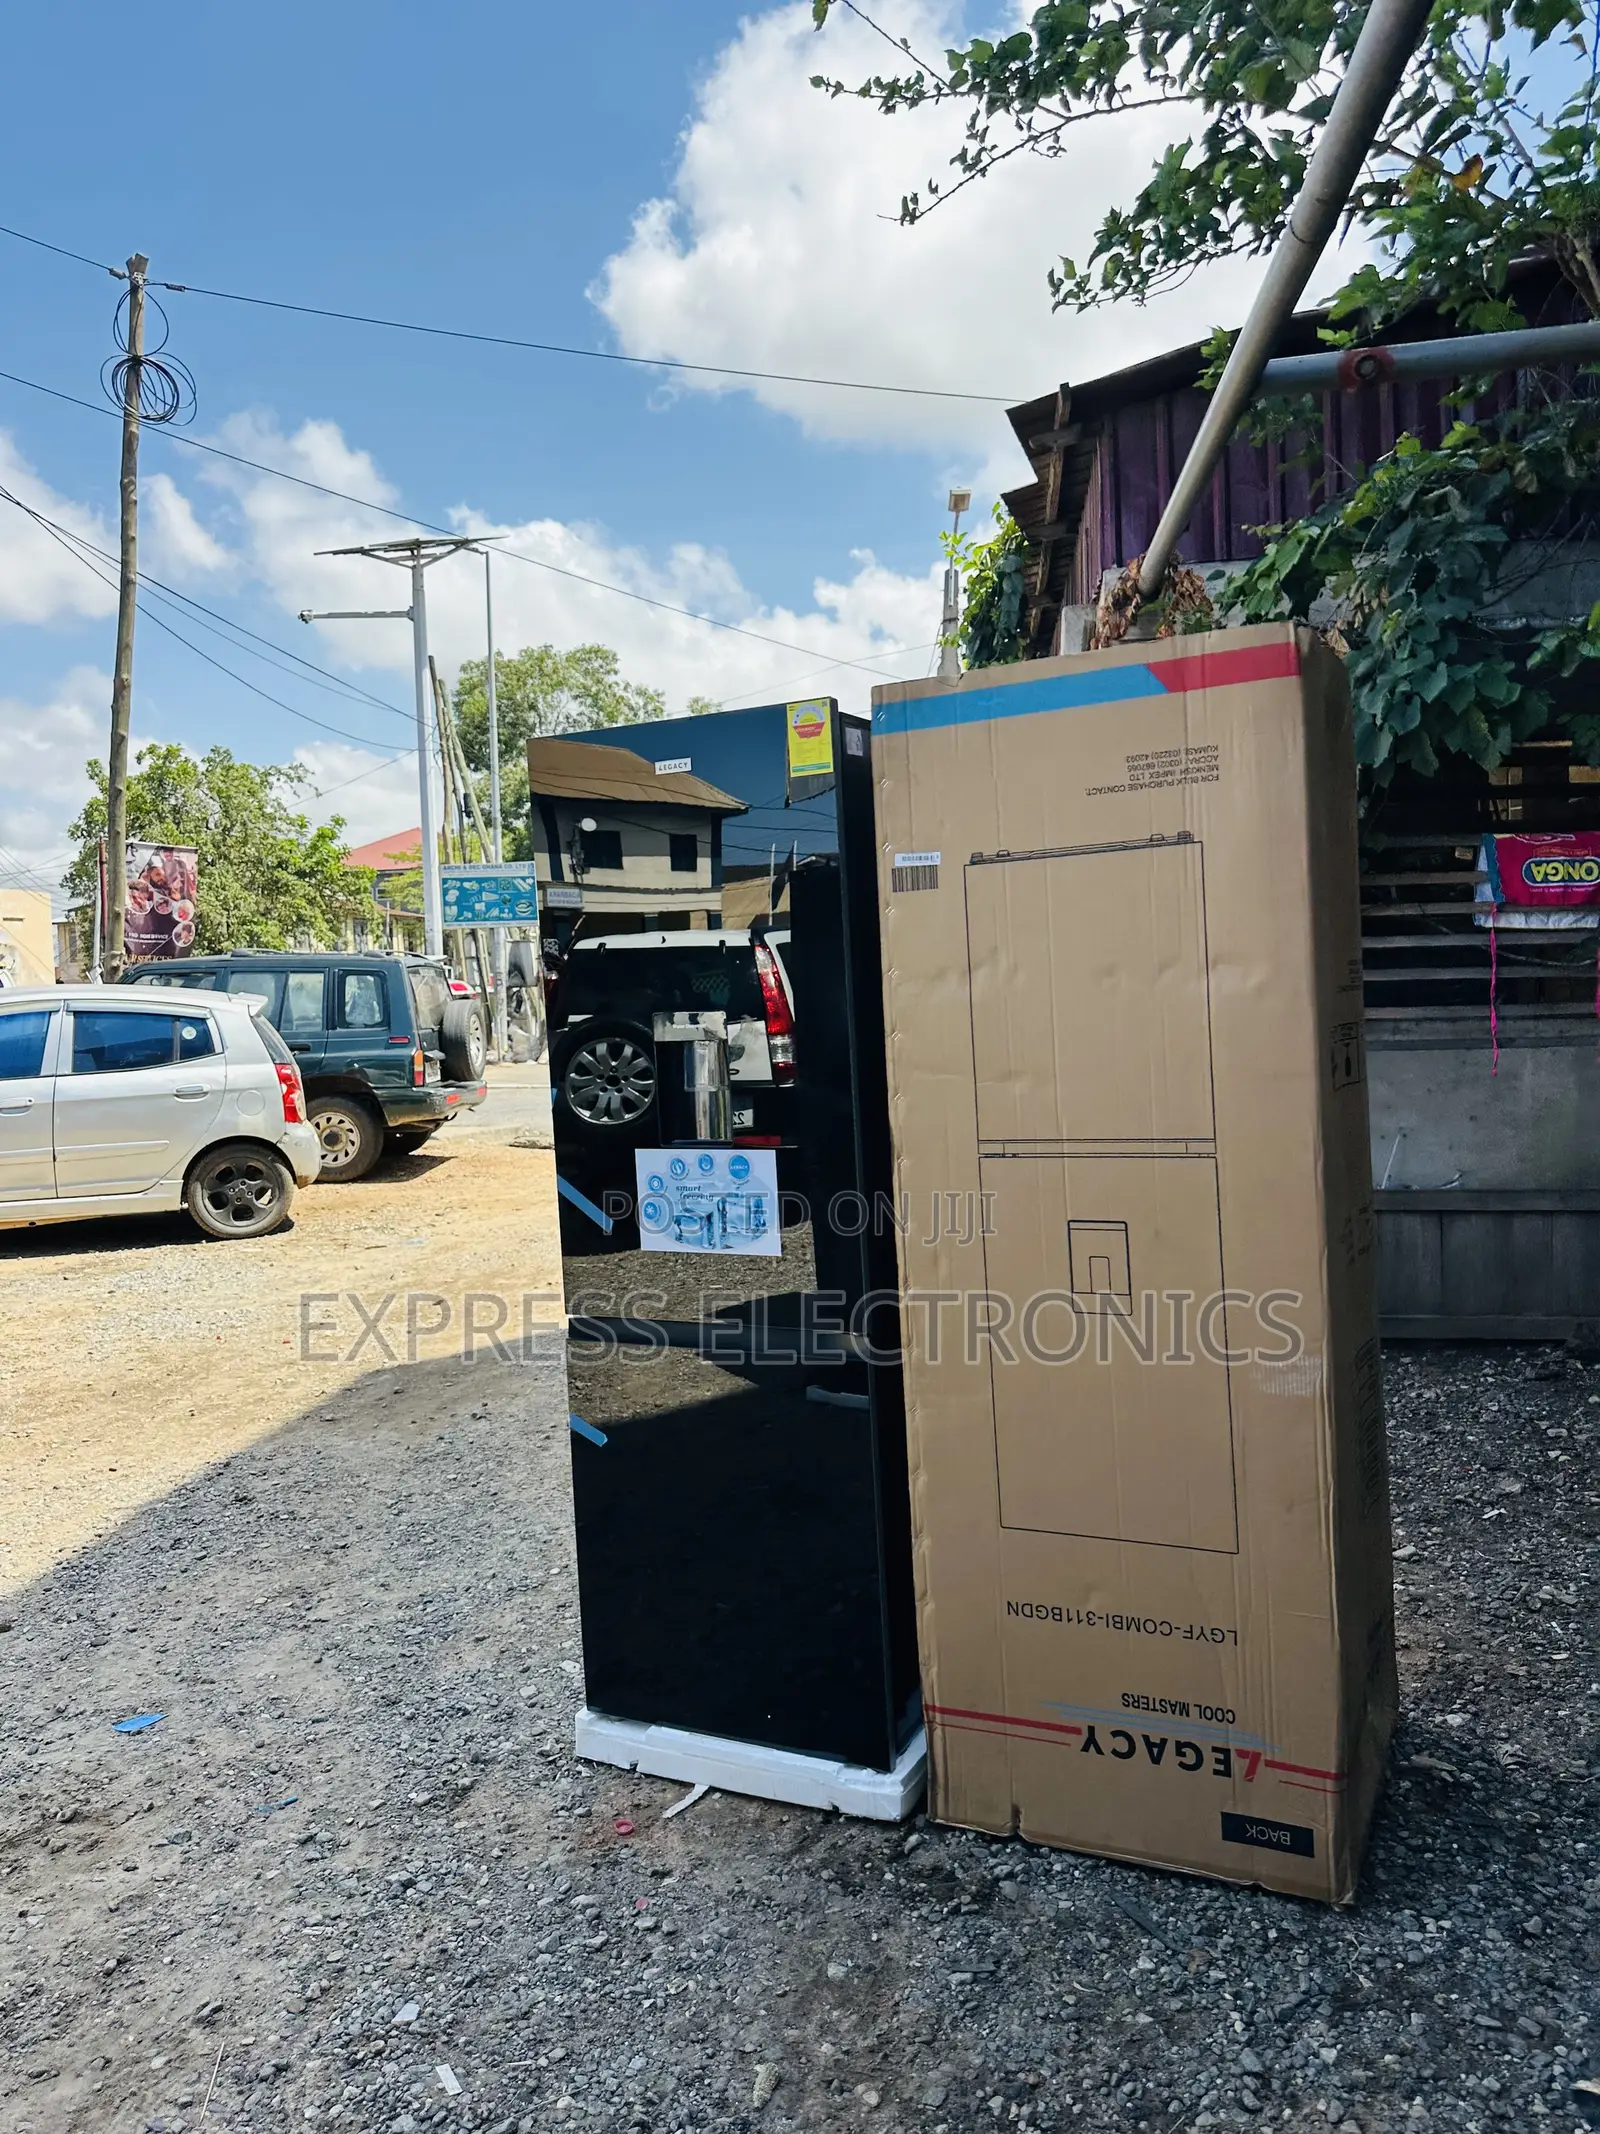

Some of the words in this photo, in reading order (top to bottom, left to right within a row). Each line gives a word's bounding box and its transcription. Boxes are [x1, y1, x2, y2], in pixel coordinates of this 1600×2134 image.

[658, 762, 688, 772] LEGACY
[1149, 769, 1176, 780] IMPEX
[1128, 778, 1175, 791] PURCHASE
[1176, 776, 1200, 786] BULK
[1201, 774, 1219, 783] FOR
[1530, 861, 1599, 882] ONGA
[1006, 1600, 1238, 1646] LGYF-COMBI-311BGDN
[1121, 1692, 1191, 1718] MASTERS
[1193, 1703, 1236, 1724] COOL
[1079, 1725, 1262, 1783] LEGACY
[1245, 1822, 1291, 1846] BACK
